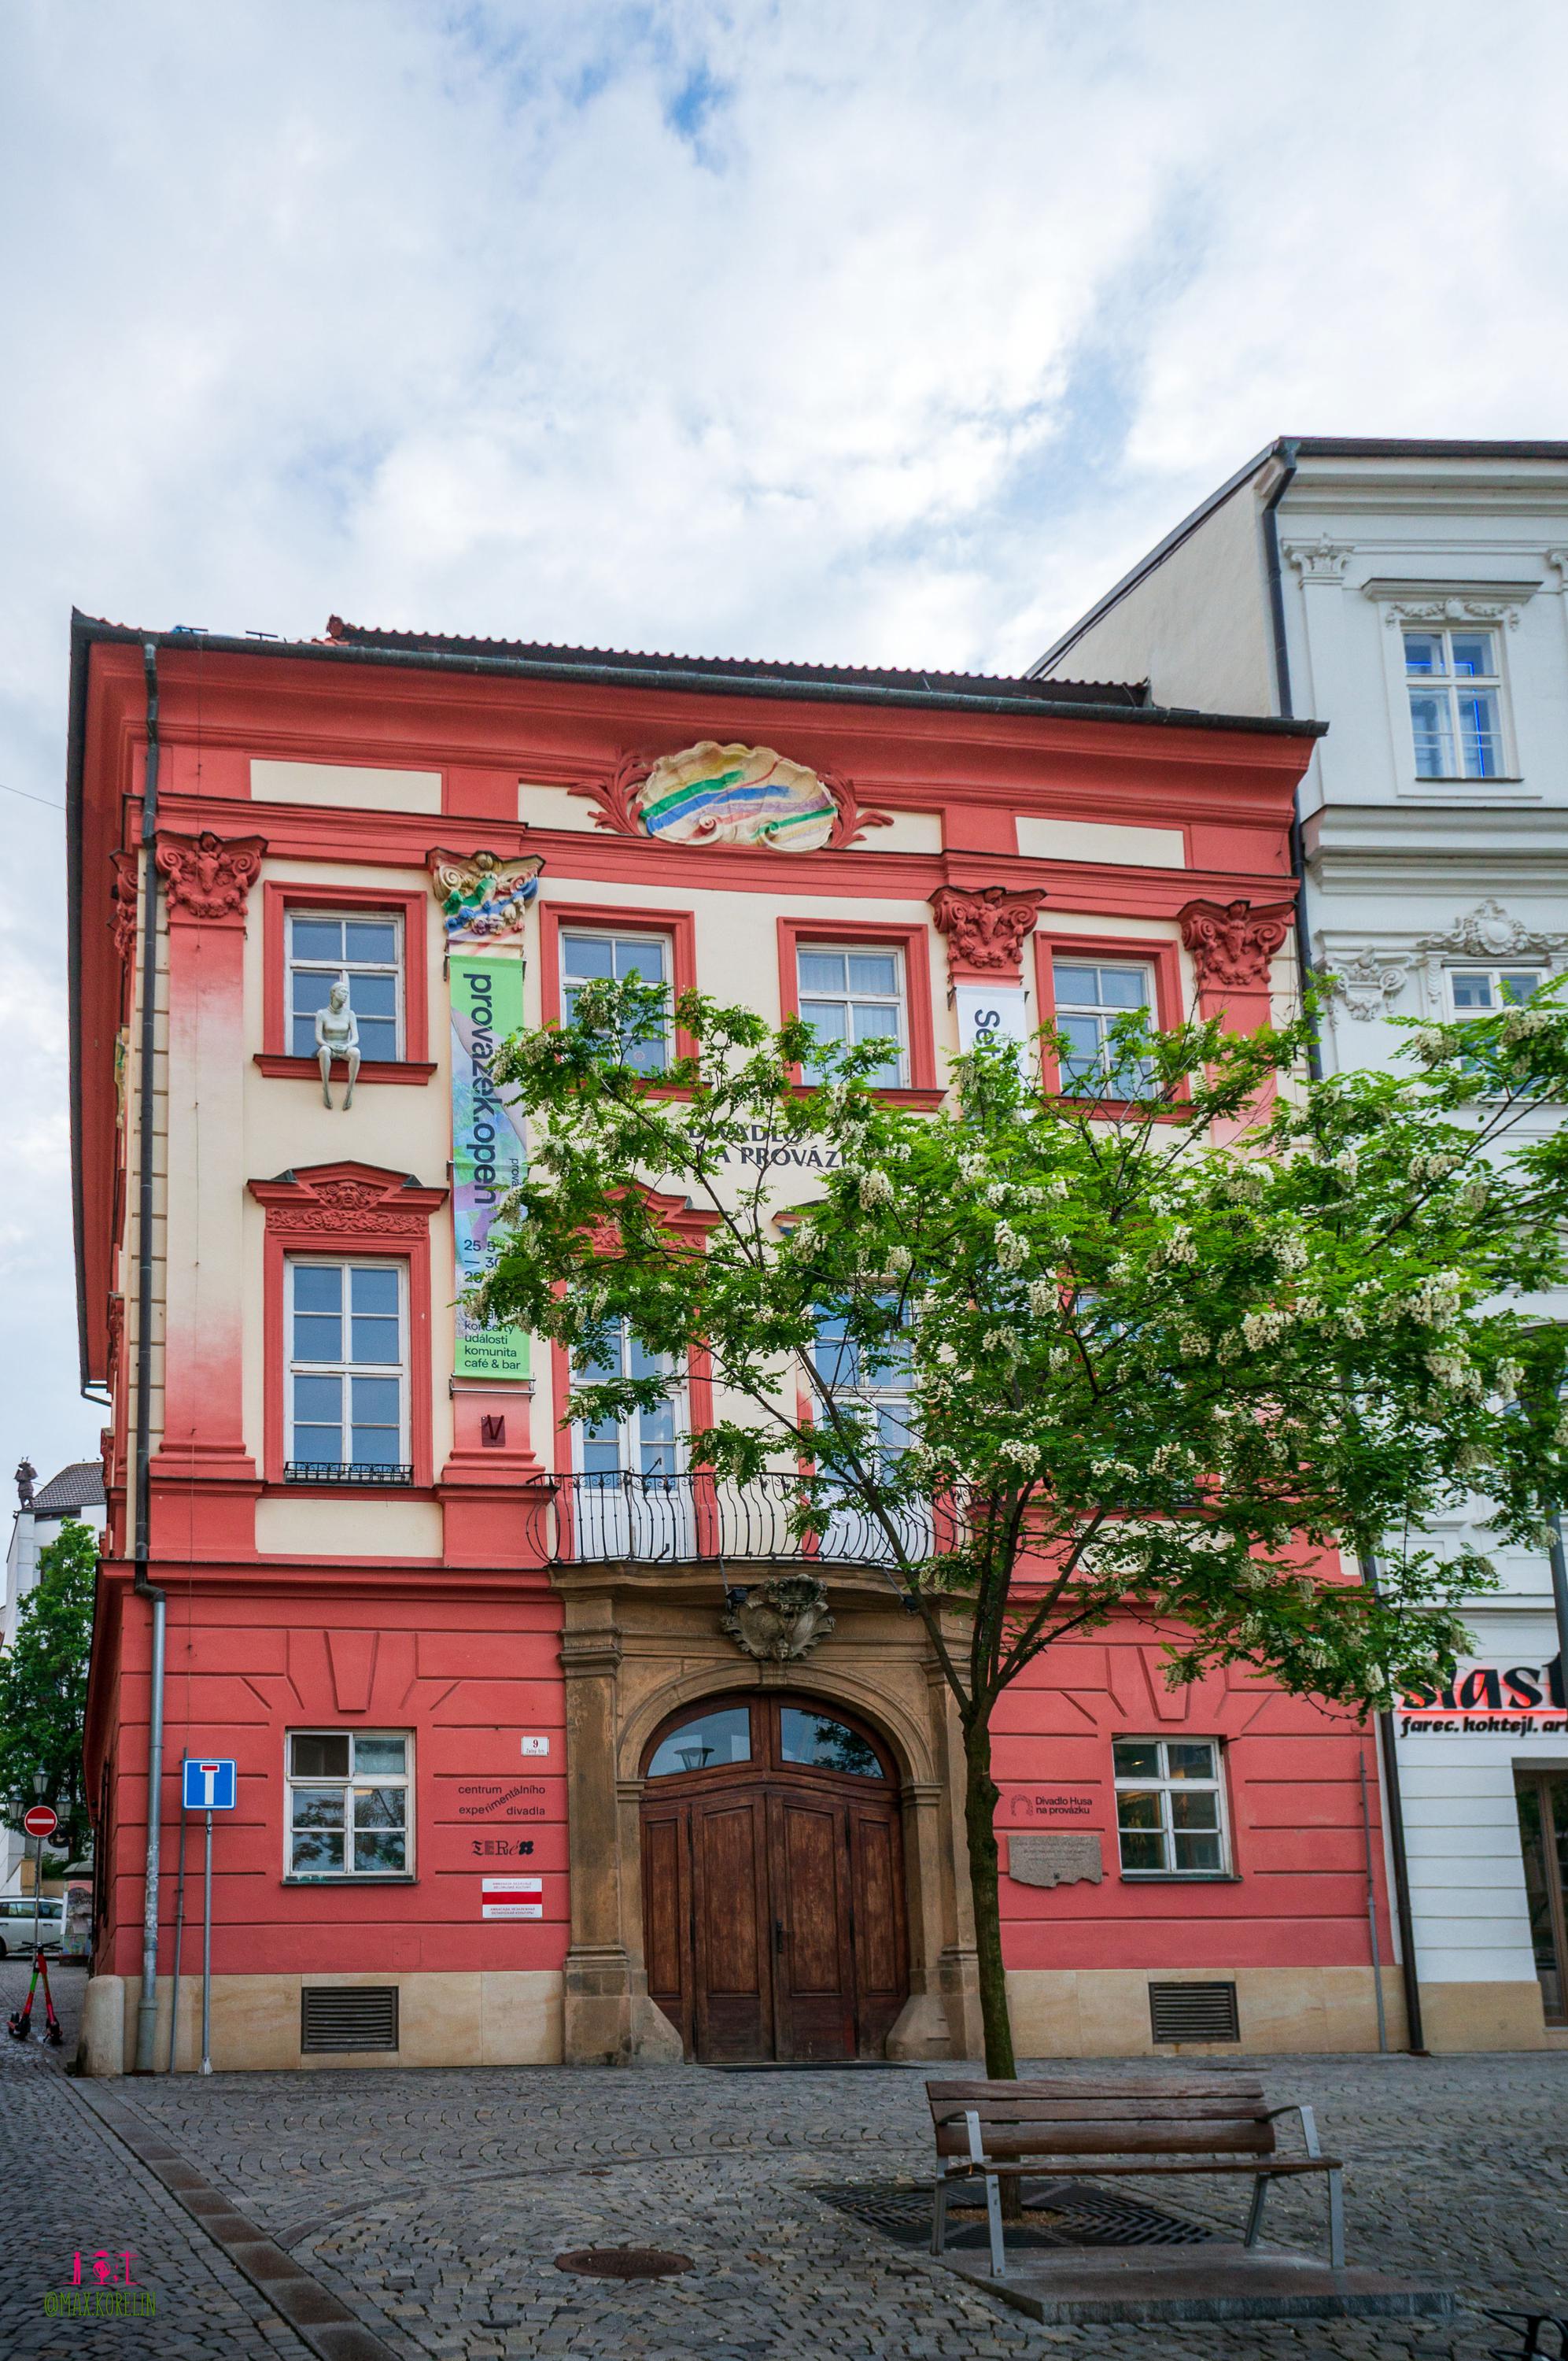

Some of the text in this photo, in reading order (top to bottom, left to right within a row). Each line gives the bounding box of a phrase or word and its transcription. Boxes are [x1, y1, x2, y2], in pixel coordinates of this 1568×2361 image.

[509, 1158, 522, 1188] prová
[464, 1240, 481, 1251] 25
[465, 1335, 508, 1345] události
[465, 1346, 517, 1358] komunita
[465, 1358, 521, 1369] café & bar
[1400, 1716, 1459, 1738] farec.
[533, 1739, 539, 1748] 9
[459, 1785, 545, 1816] experimentálního
[507, 1806, 545, 1815] divadla
[1050, 1806, 1090, 1816] provázku
